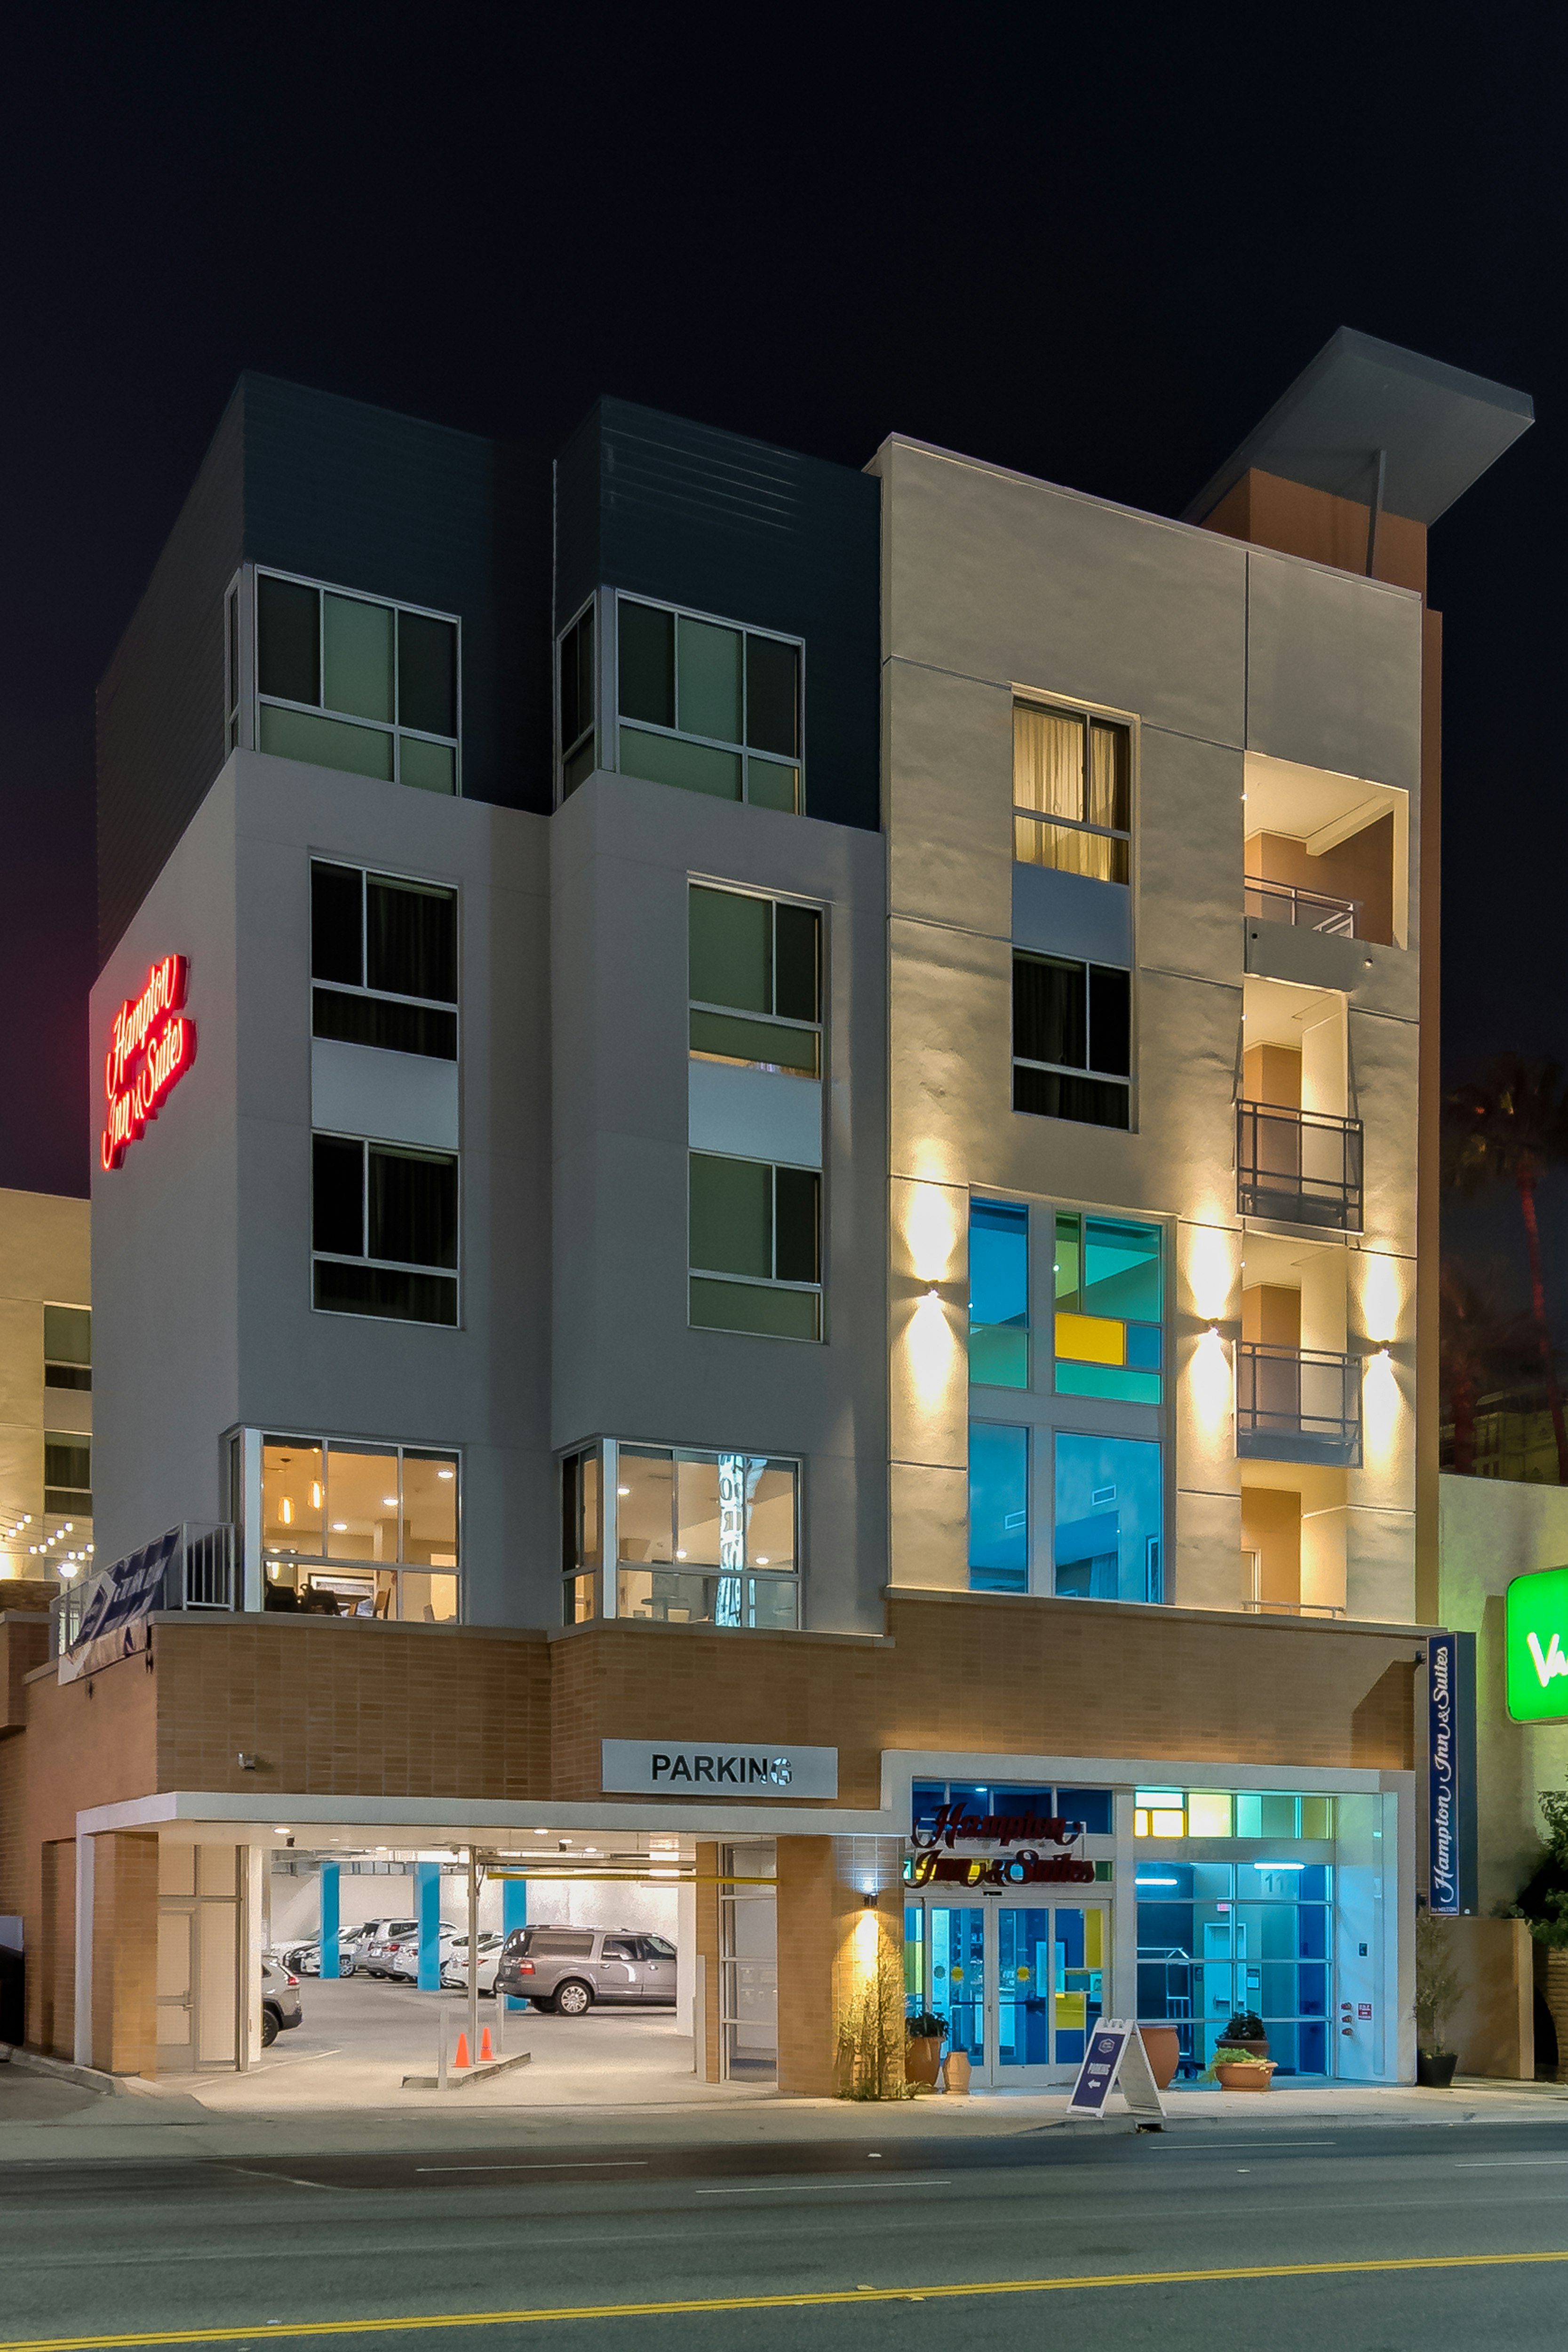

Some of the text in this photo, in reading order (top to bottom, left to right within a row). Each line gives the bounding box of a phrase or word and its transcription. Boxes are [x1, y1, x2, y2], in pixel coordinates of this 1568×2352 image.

[105, 953, 183, 1100] Hampton
[102, 1091, 136, 1170] Inn
[142, 1016, 189, 1108] Suites
[652, 1754, 793, 1787] PARKING
[1433, 1646, 1454, 1902] Hampton Inn & Suites
[904, 1849, 988, 1889] Inn
[1004, 1849, 1095, 1885] Suites
[911, 1803, 1082, 1849] Hampton
